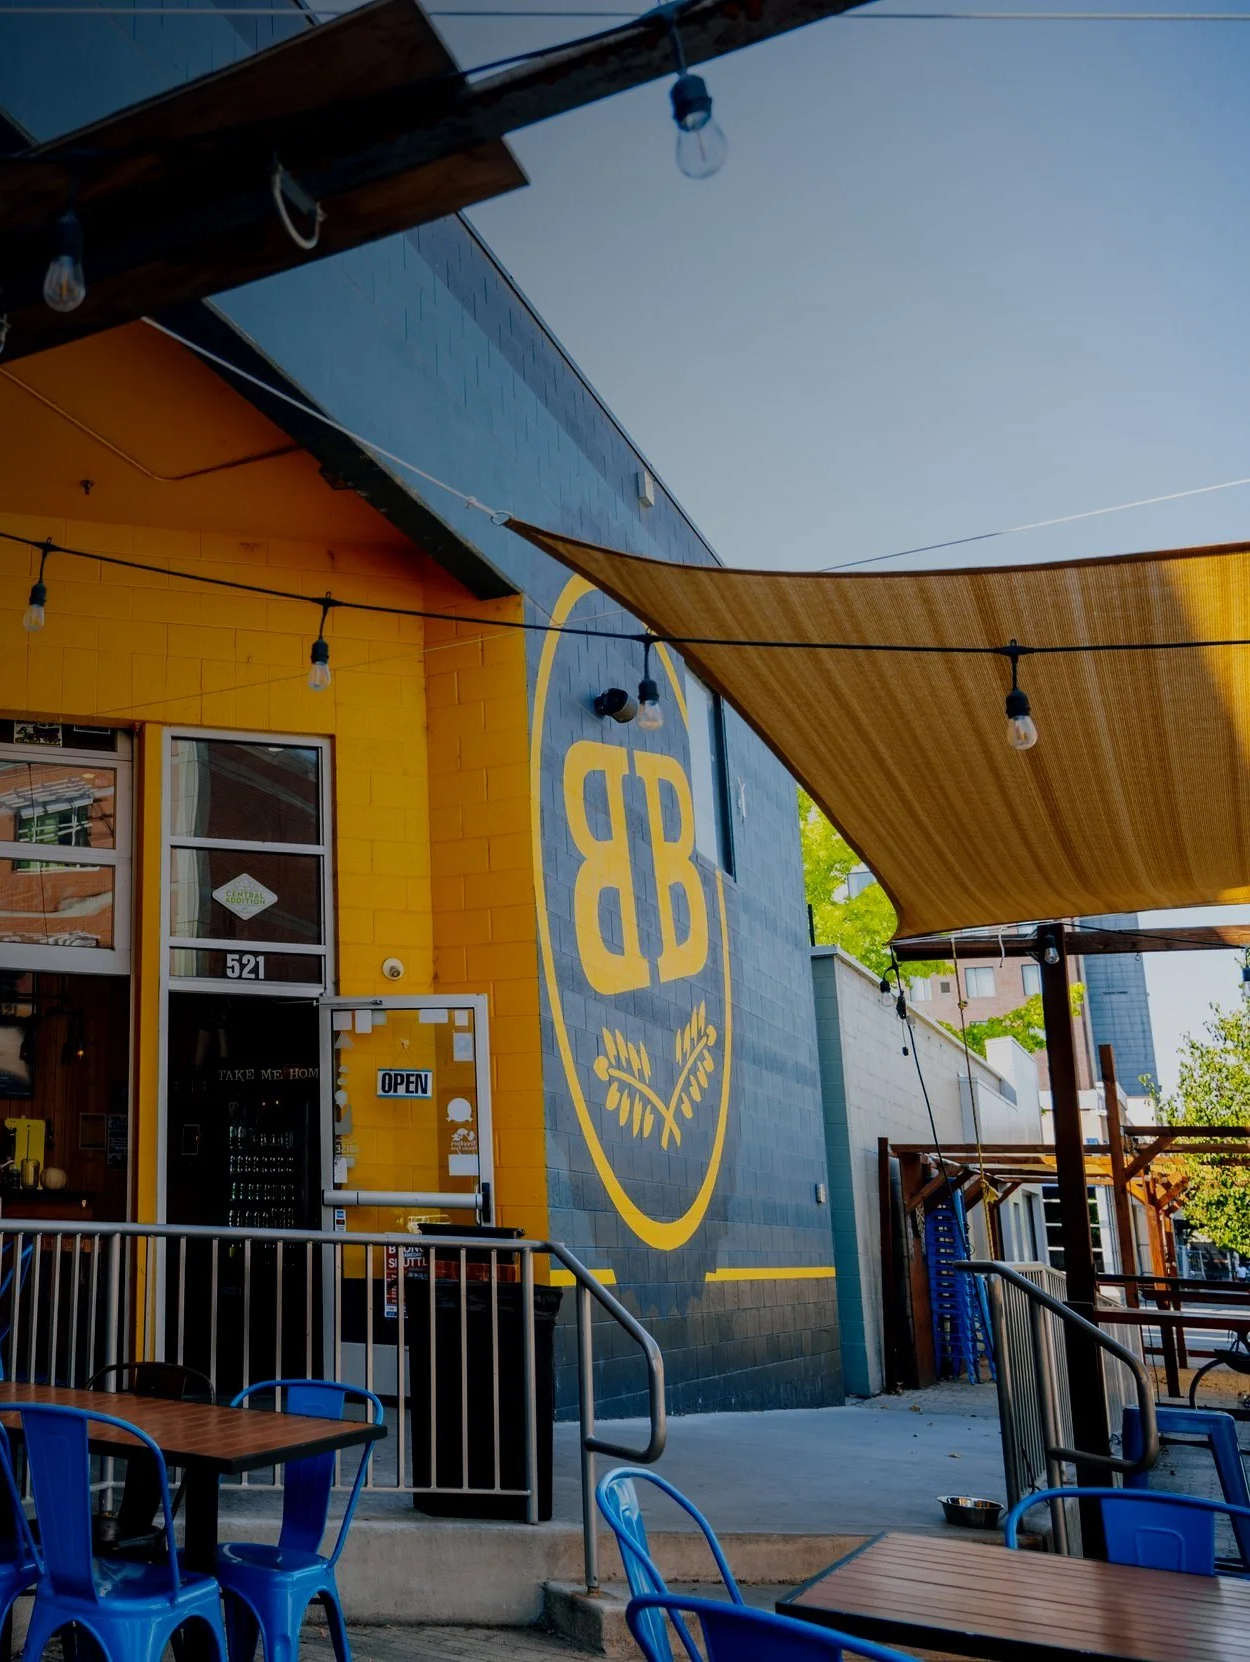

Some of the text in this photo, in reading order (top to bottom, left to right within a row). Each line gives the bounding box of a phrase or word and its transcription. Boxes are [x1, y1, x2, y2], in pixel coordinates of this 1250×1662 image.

[225, 891, 264, 899] CENTRAL
[225, 897, 265, 905] ADDITION
[226, 954, 265, 980] 521
[217, 1067, 319, 1082] TAKE ME HOM
[381, 1072, 428, 1095] OPEN
